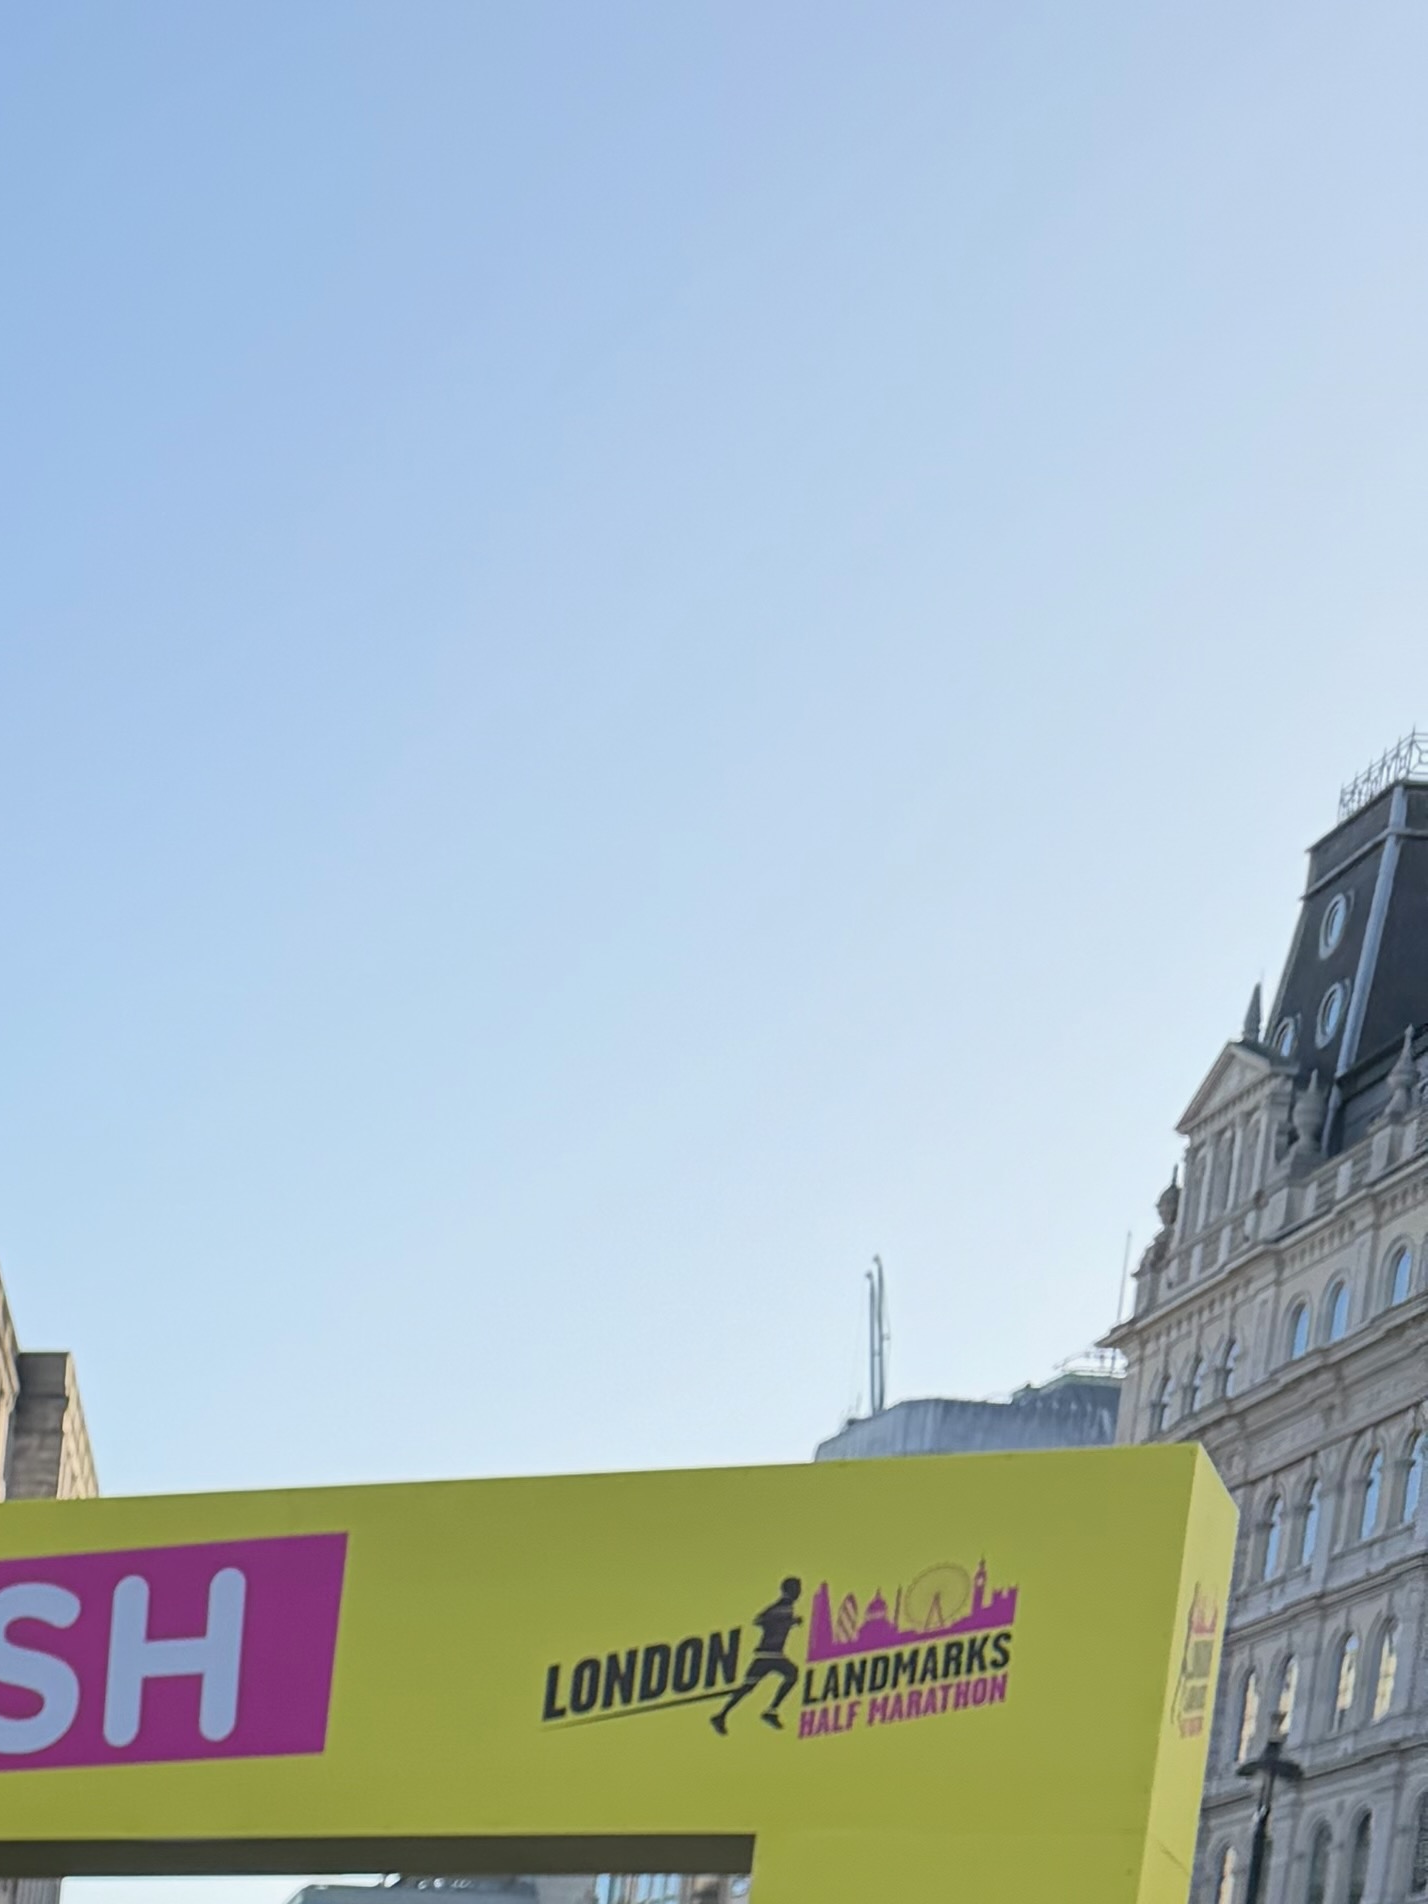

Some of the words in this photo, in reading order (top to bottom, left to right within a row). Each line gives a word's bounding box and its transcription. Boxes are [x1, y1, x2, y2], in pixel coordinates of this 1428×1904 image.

[542, 1627, 743, 1722] LONDON
[798, 1701, 862, 1739] HALF
[866, 1672, 1009, 1727] MARATHON
[802, 1631, 1012, 1706] LANDMARKS
